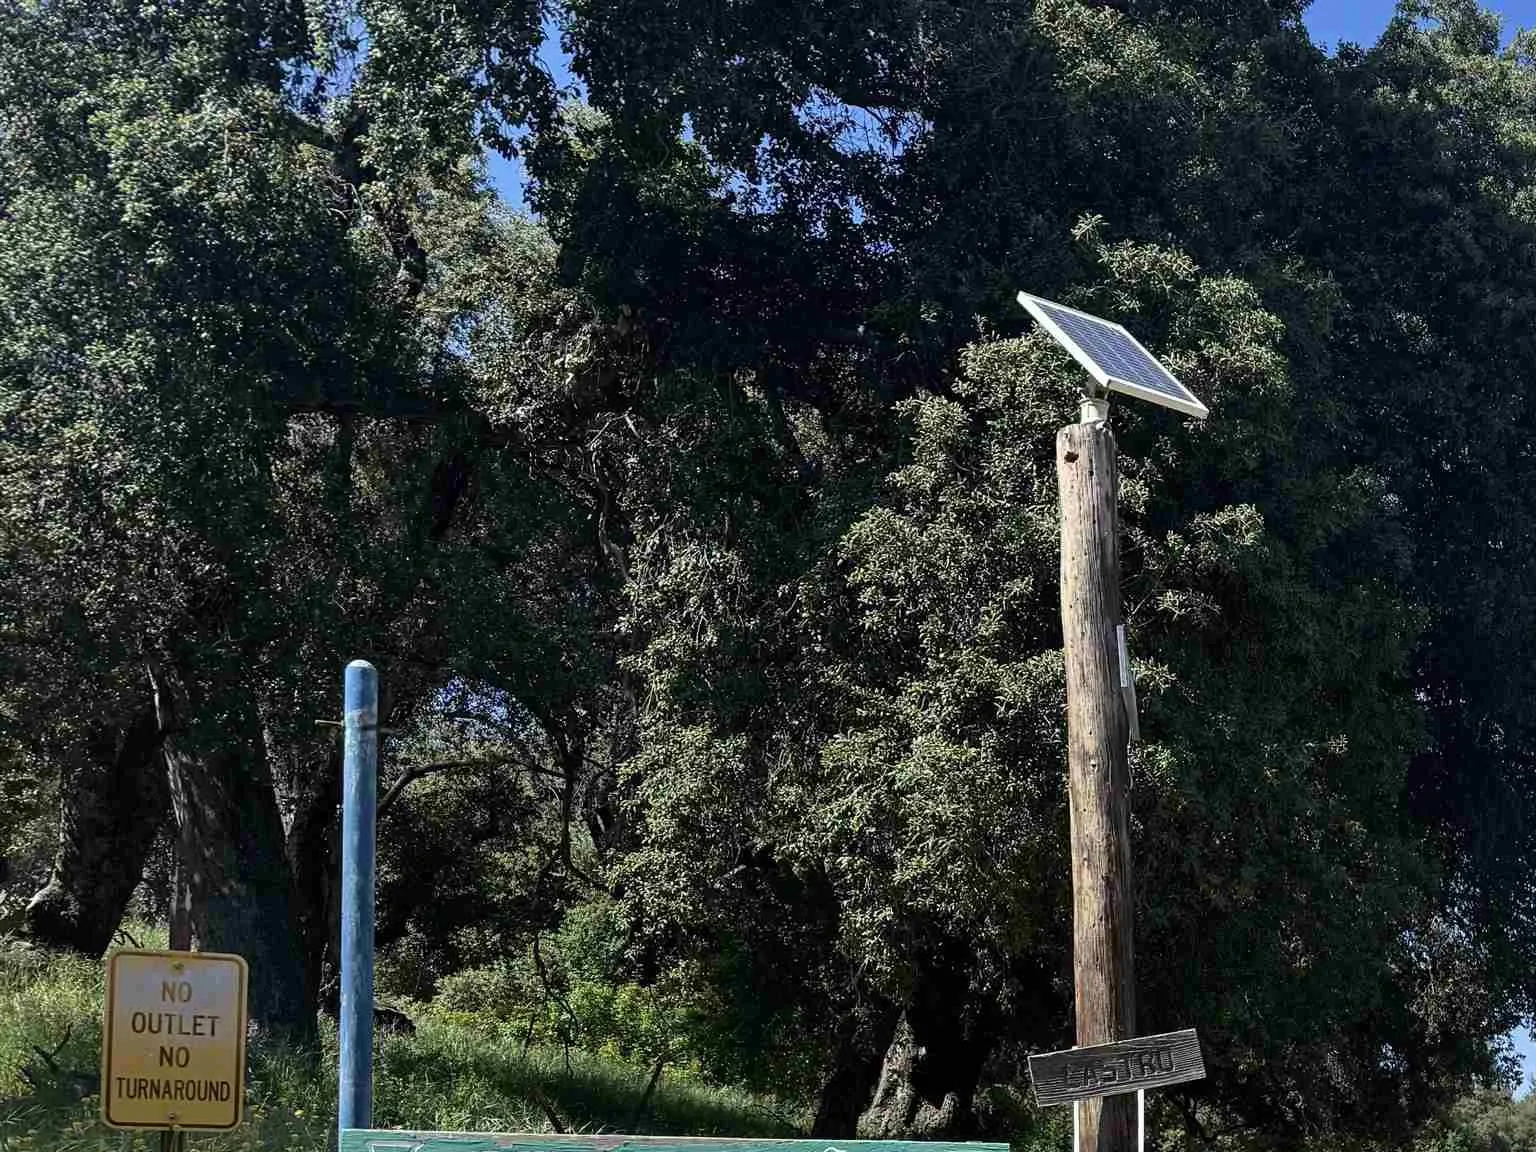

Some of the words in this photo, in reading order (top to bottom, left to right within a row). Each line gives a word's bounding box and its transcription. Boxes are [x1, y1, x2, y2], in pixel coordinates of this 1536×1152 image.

[162, 981, 193, 1003] NO
[131, 1012, 220, 1037] OUTLET
[159, 1046, 190, 1068] NO
[116, 1077, 231, 1102] TURNAROUND
